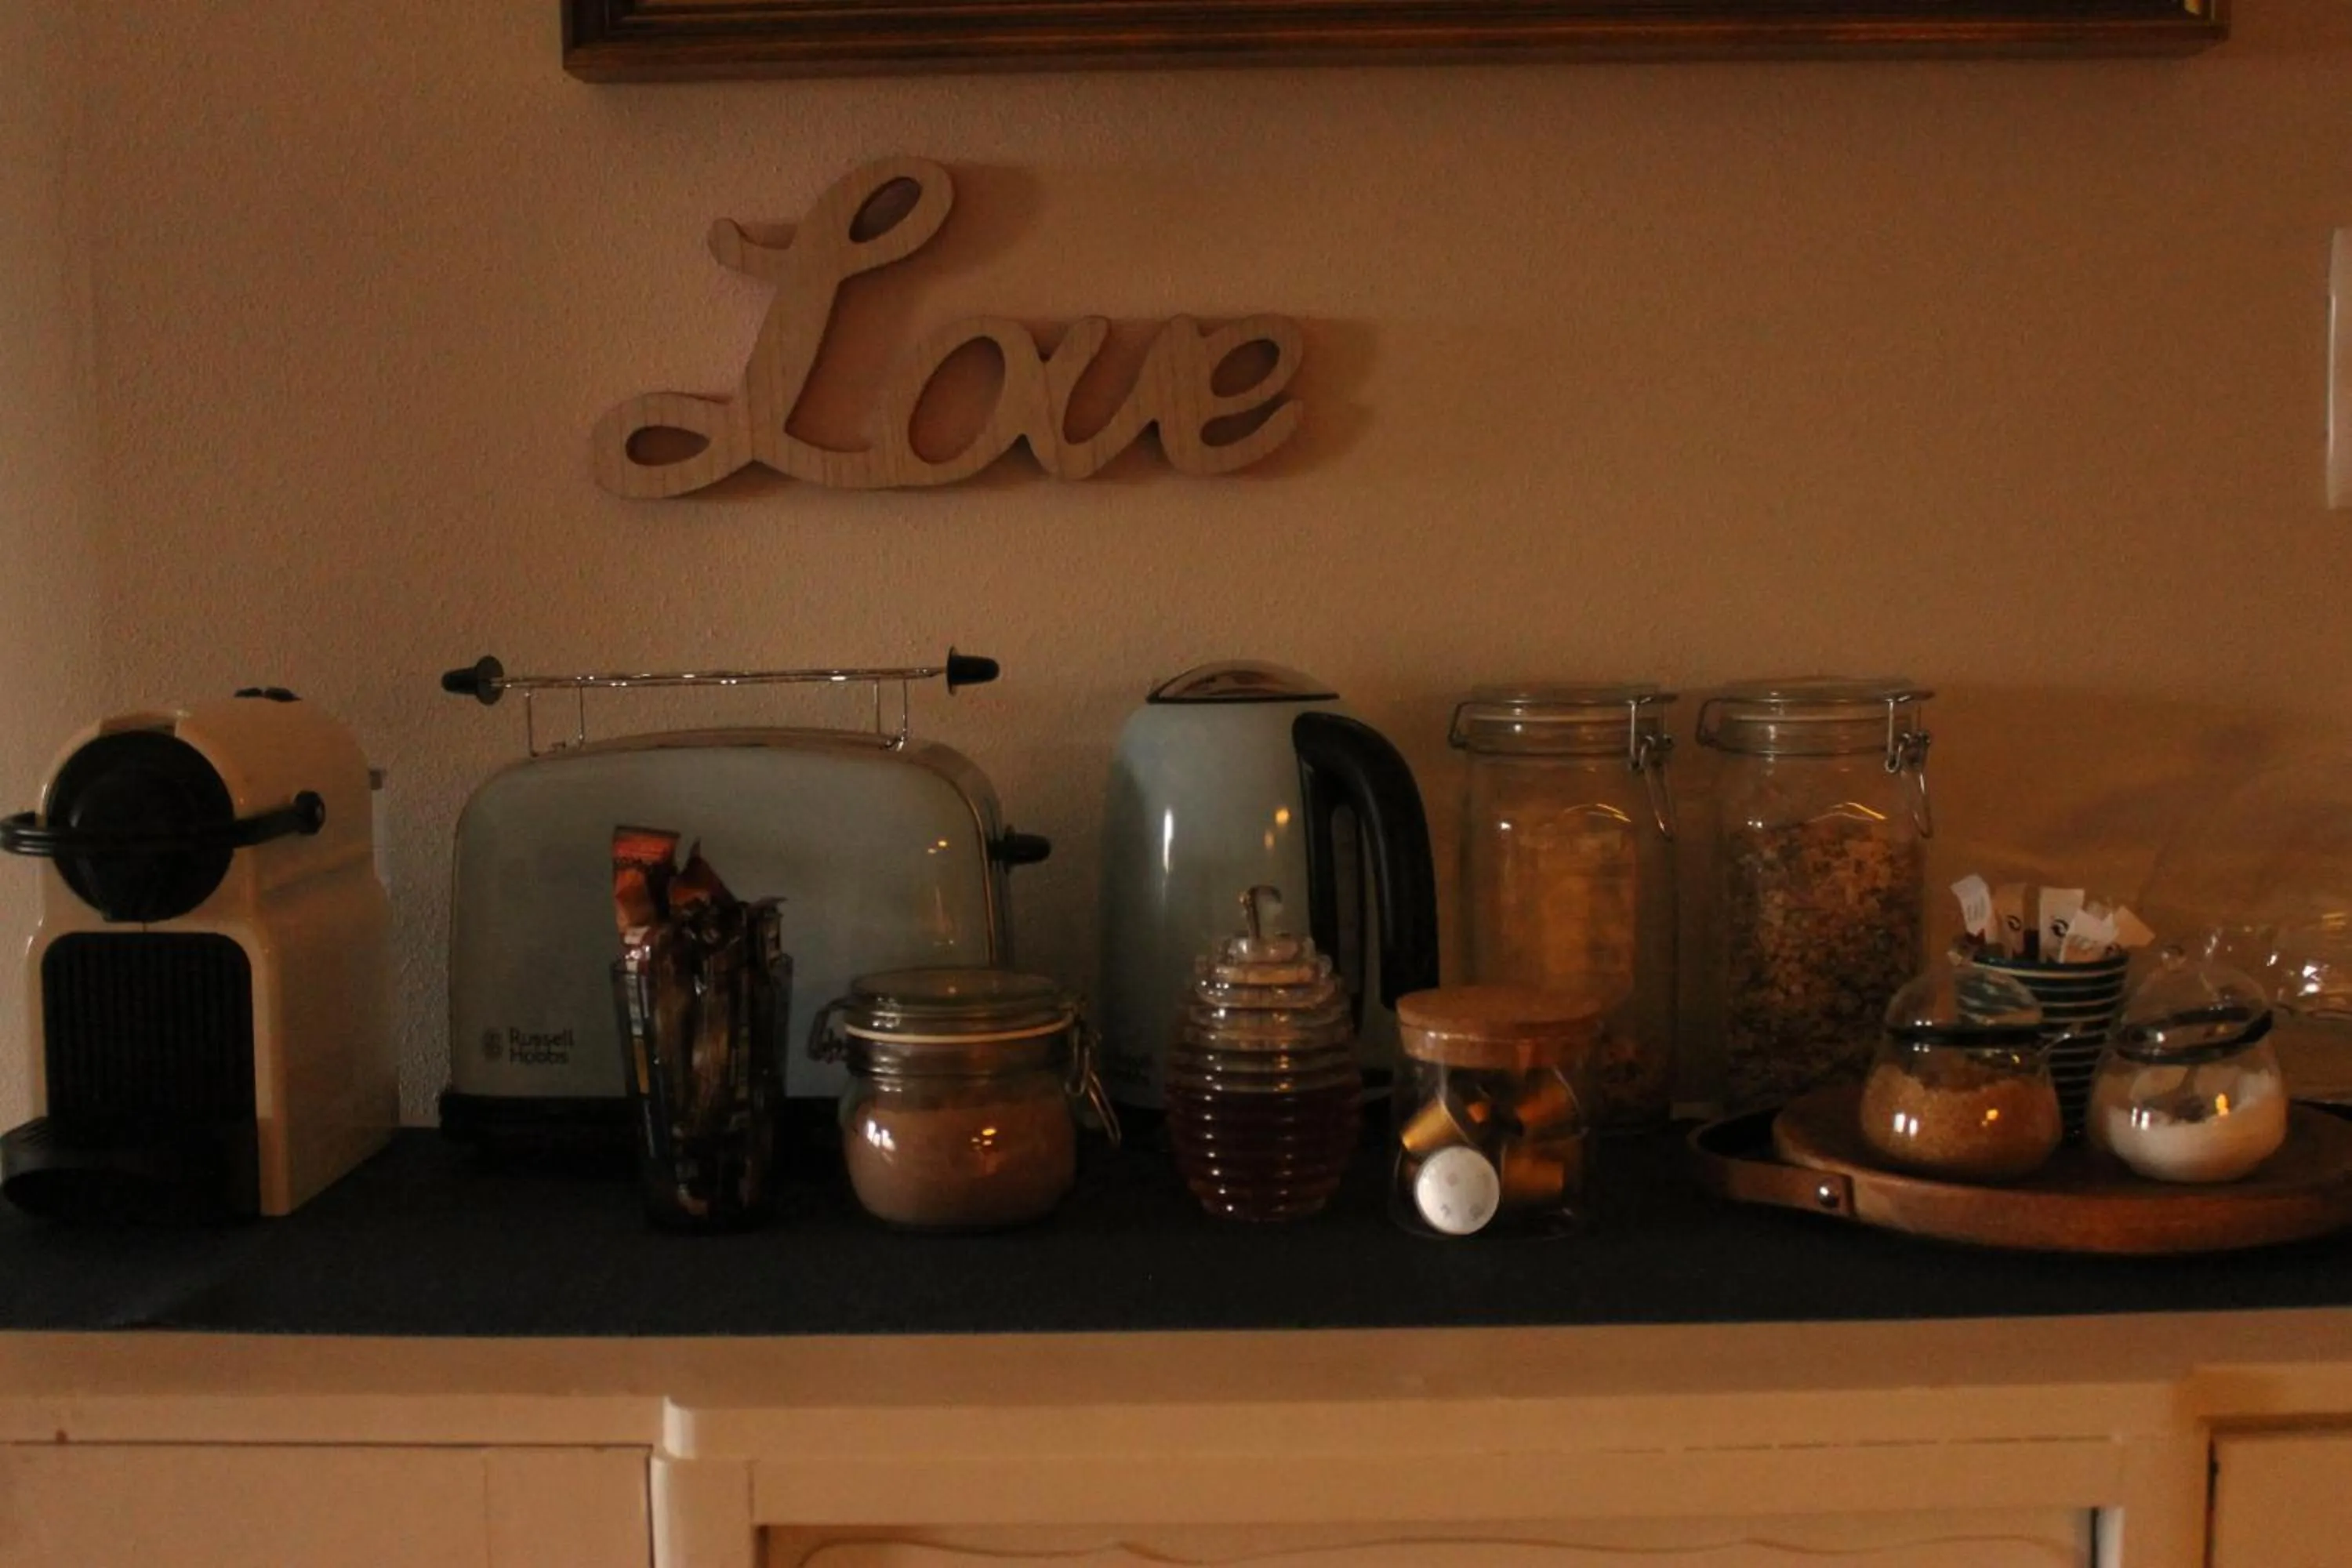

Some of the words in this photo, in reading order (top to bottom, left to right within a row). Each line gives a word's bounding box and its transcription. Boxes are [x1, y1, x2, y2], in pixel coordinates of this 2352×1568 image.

[592, 157, 1305, 499] Love
[510, 1027, 574, 1047] Russell
[510, 1047, 570, 1065] Hobbs
